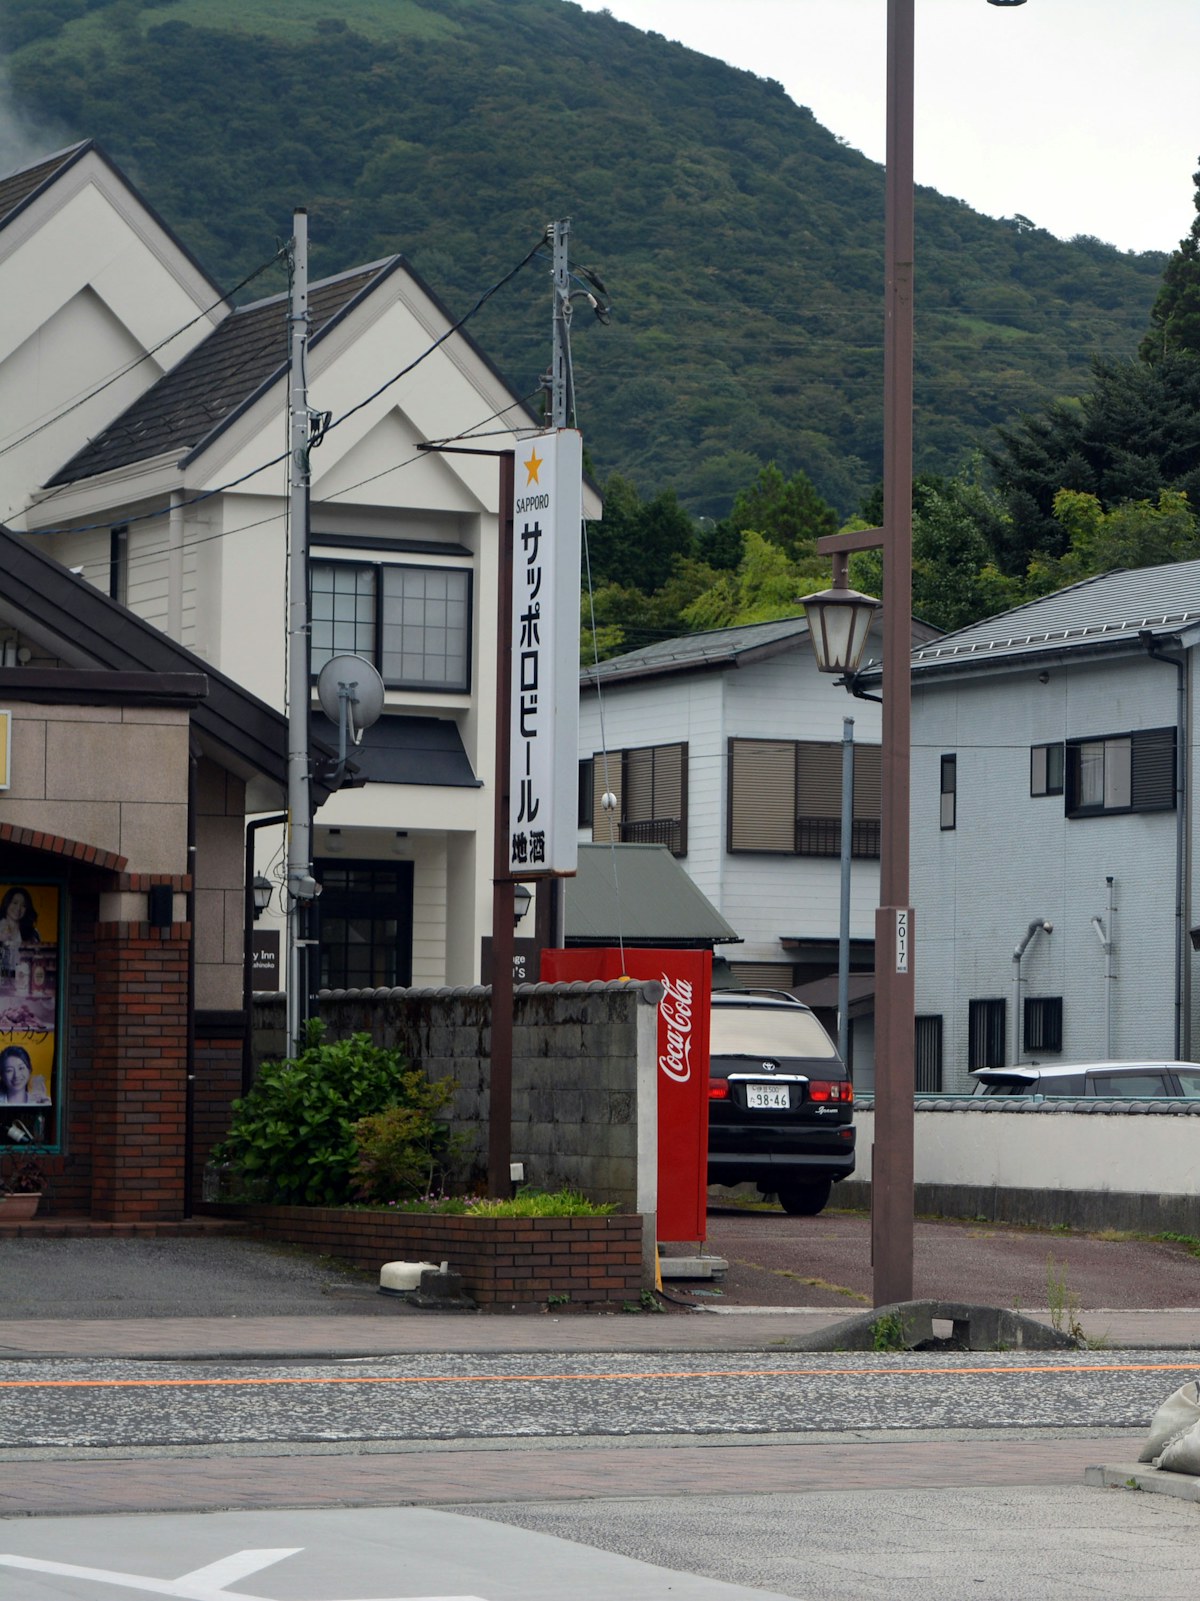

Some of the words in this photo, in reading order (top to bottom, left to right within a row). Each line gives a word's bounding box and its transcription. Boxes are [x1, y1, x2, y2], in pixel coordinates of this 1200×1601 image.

[516, 493, 549, 514] SAPPORO
[517, 521, 542, 823] サッポロビール
[511, 830, 545, 863] 地酒
[898, 913, 906, 963] Z017
[261, 950, 275, 960] Inn
